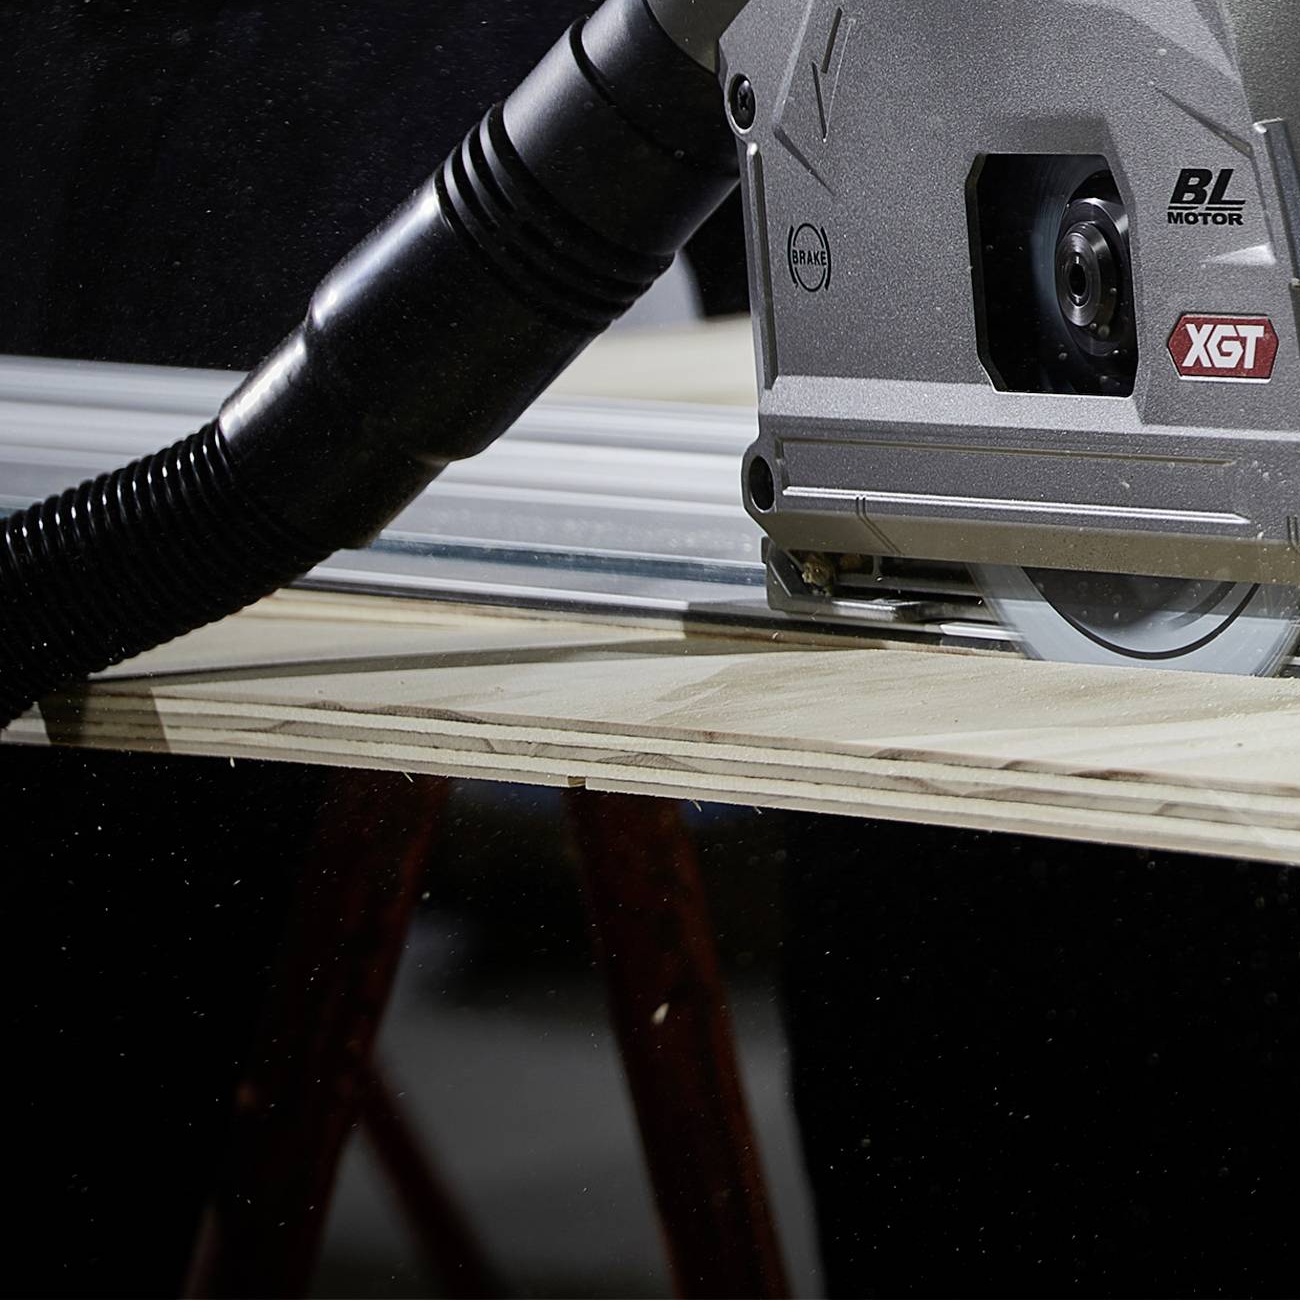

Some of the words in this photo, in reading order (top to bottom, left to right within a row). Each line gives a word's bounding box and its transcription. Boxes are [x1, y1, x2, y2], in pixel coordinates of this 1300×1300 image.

[1169, 168, 1246, 205] BL
[1167, 211, 1245, 226] MOTOR
[792, 248, 827, 266] BRAKE
[1181, 323, 1265, 369] XGT
